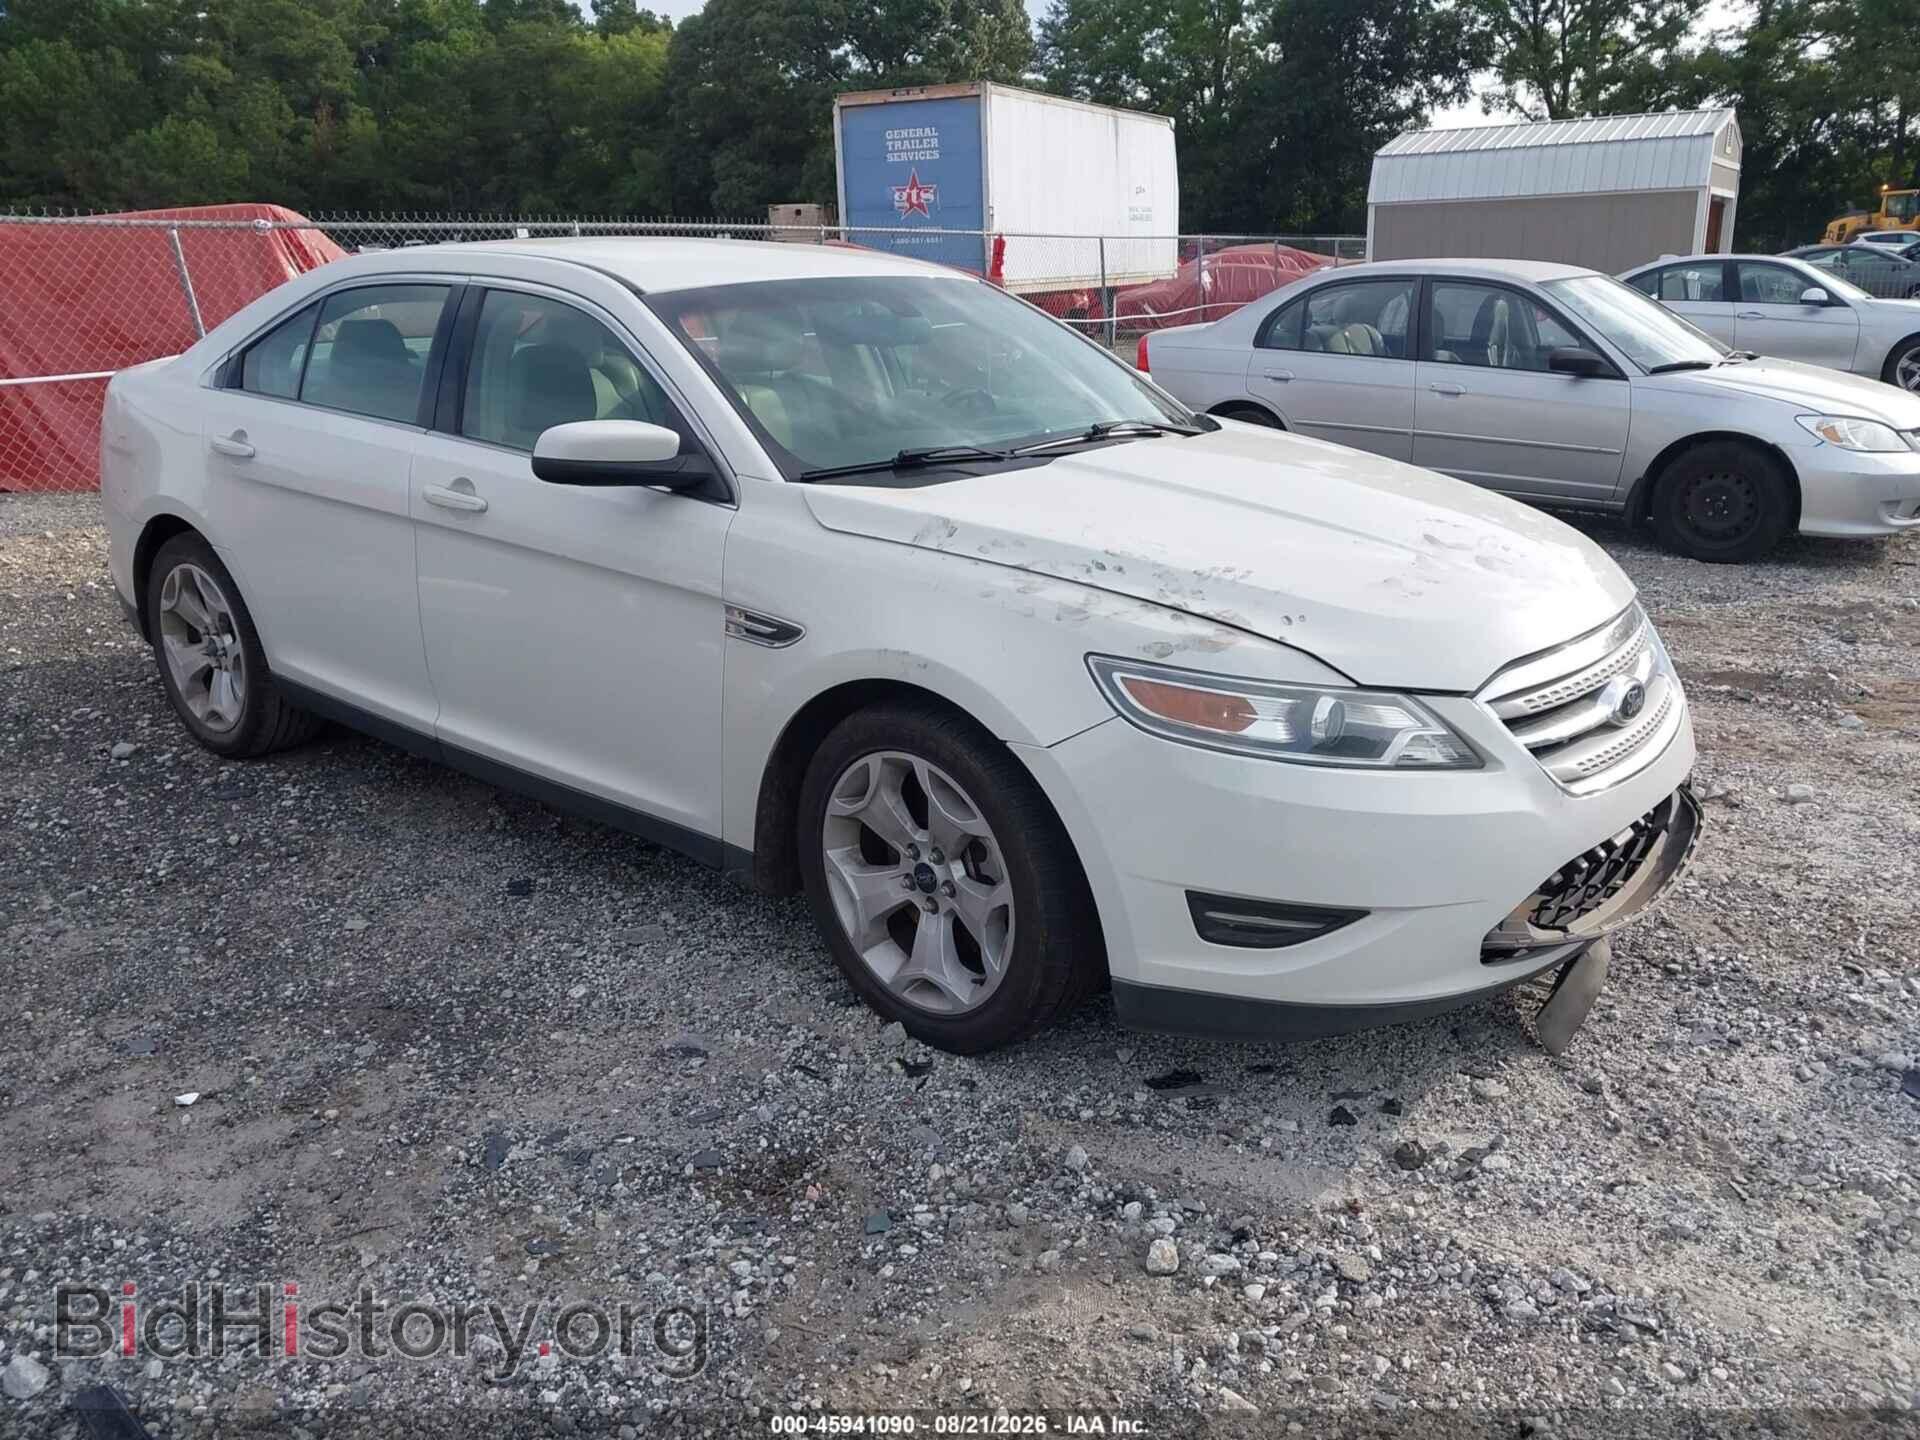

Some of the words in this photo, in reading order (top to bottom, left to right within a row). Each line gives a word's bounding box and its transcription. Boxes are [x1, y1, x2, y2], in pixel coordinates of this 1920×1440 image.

[885, 127, 939, 140] GENERAL
[886, 137, 939, 151] TRAILER
[886, 149, 940, 162] SERVICES
[894, 188, 935, 211] gts
